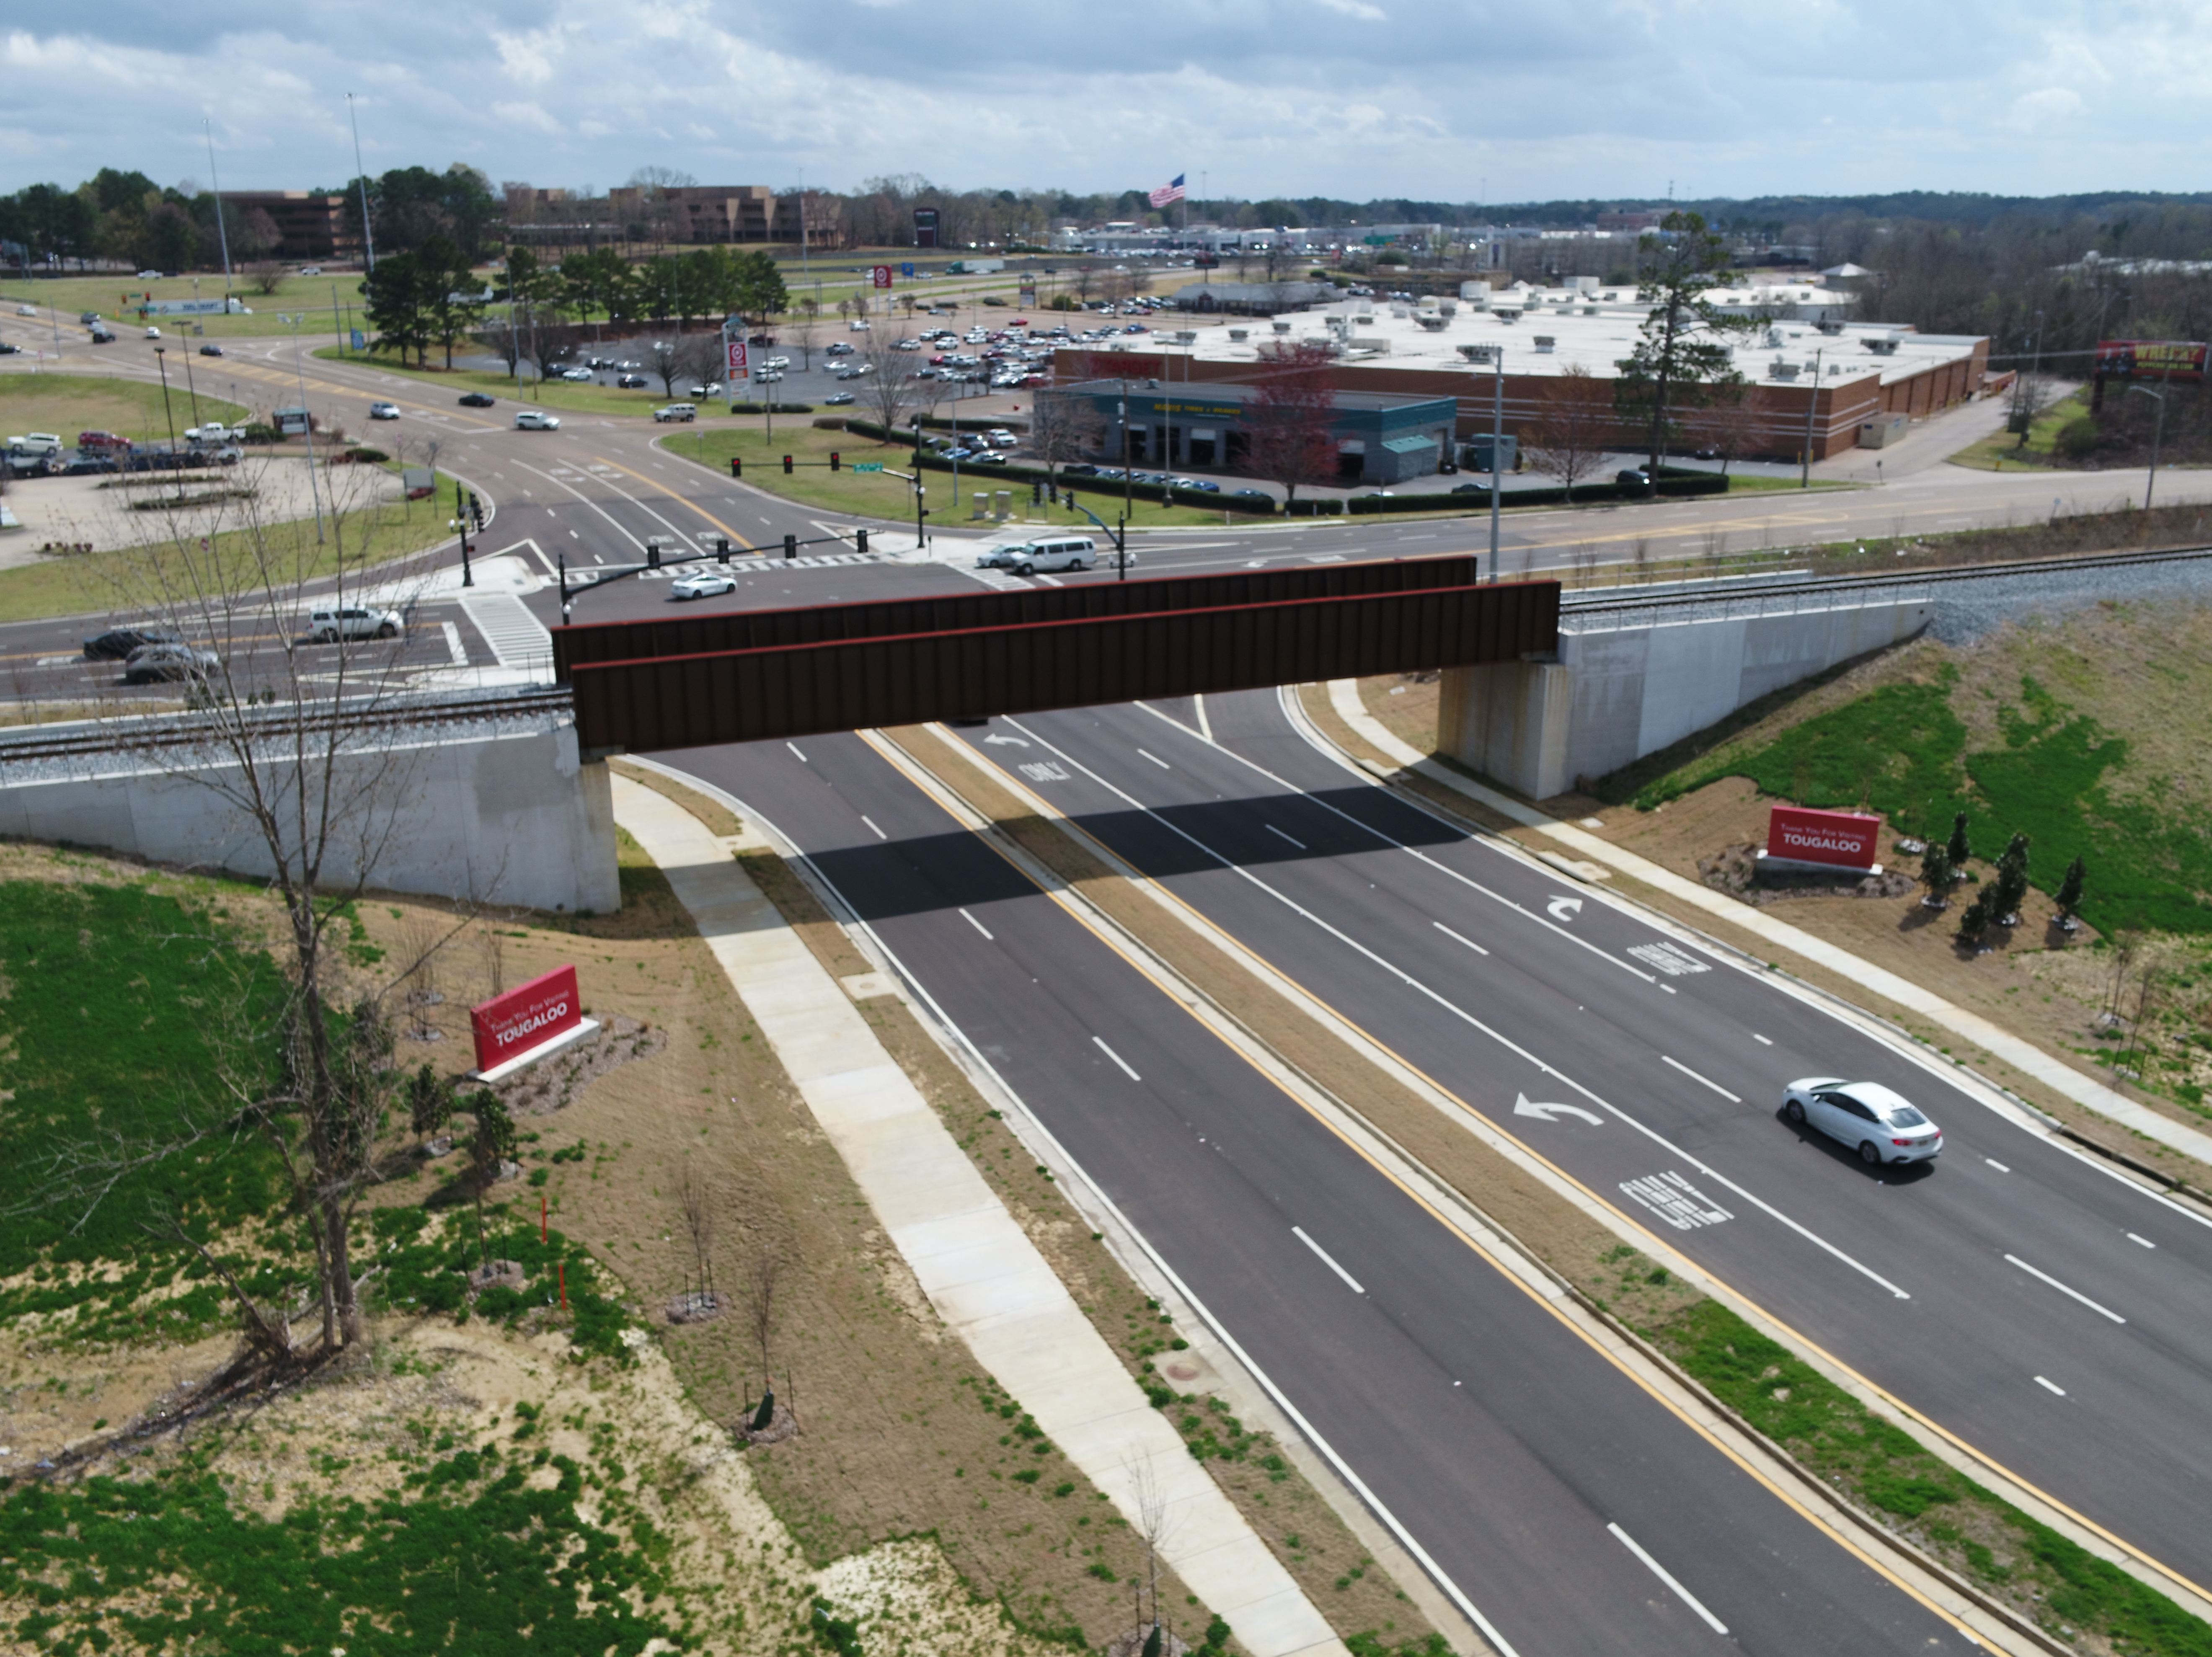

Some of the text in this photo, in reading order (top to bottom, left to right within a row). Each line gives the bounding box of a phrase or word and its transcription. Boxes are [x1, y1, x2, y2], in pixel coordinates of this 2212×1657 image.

[1783, 833, 1861, 852] TOUGALOO
[1627, 942, 1712, 975] ONLY
[496, 1002, 567, 1046] TOUGALOO
[1619, 1170, 1734, 1230] ONLY
